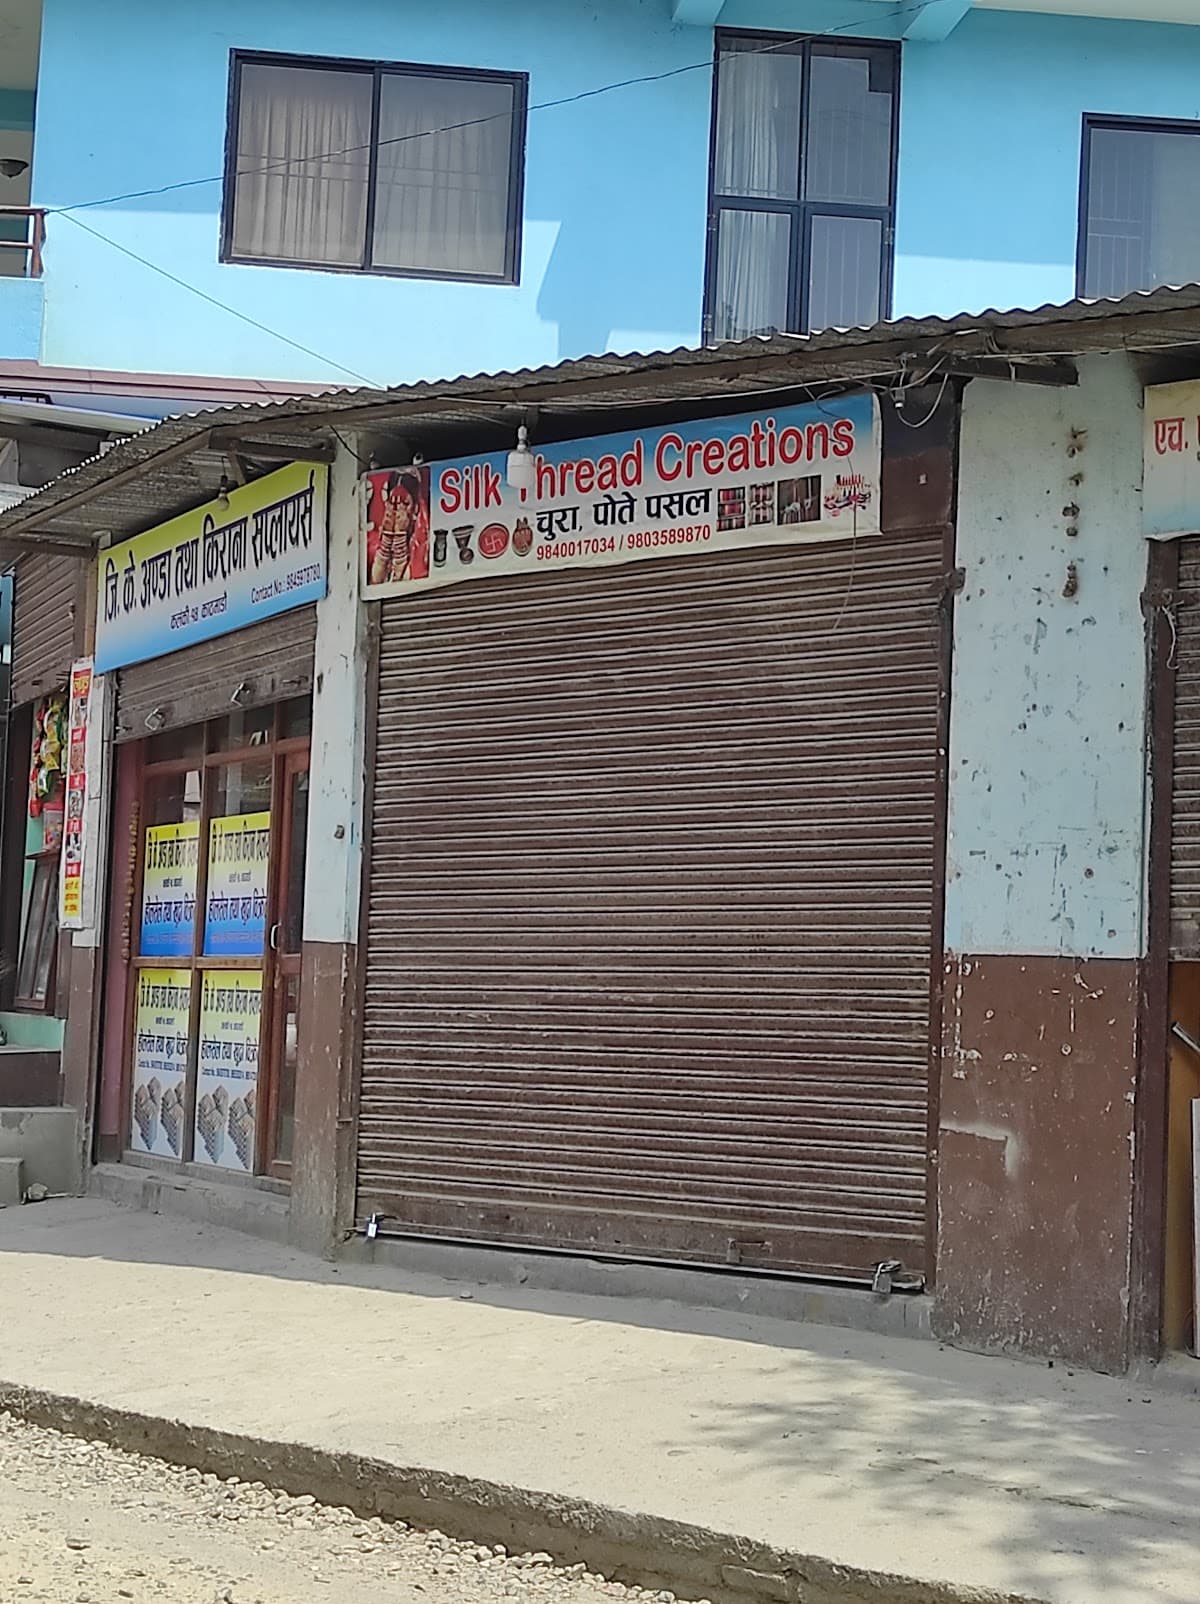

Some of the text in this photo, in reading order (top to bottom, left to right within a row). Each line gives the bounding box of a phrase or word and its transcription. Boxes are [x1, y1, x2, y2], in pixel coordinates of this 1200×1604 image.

[1153, 418, 1188, 455] एच.
[440, 418, 855, 514] Silk hread Creations
[536, 488, 713, 541] चुरा, पोते पसल
[140, 549, 173, 609] अण्डा
[175, 536, 199, 598] तथा
[202, 513, 249, 585] किराना
[252, 468, 315, 569] सप्लायर्स
[536, 536, 616, 561] 9840017034
[627, 524, 712, 549] 9803589870
[251, 582, 273, 604] Contact
